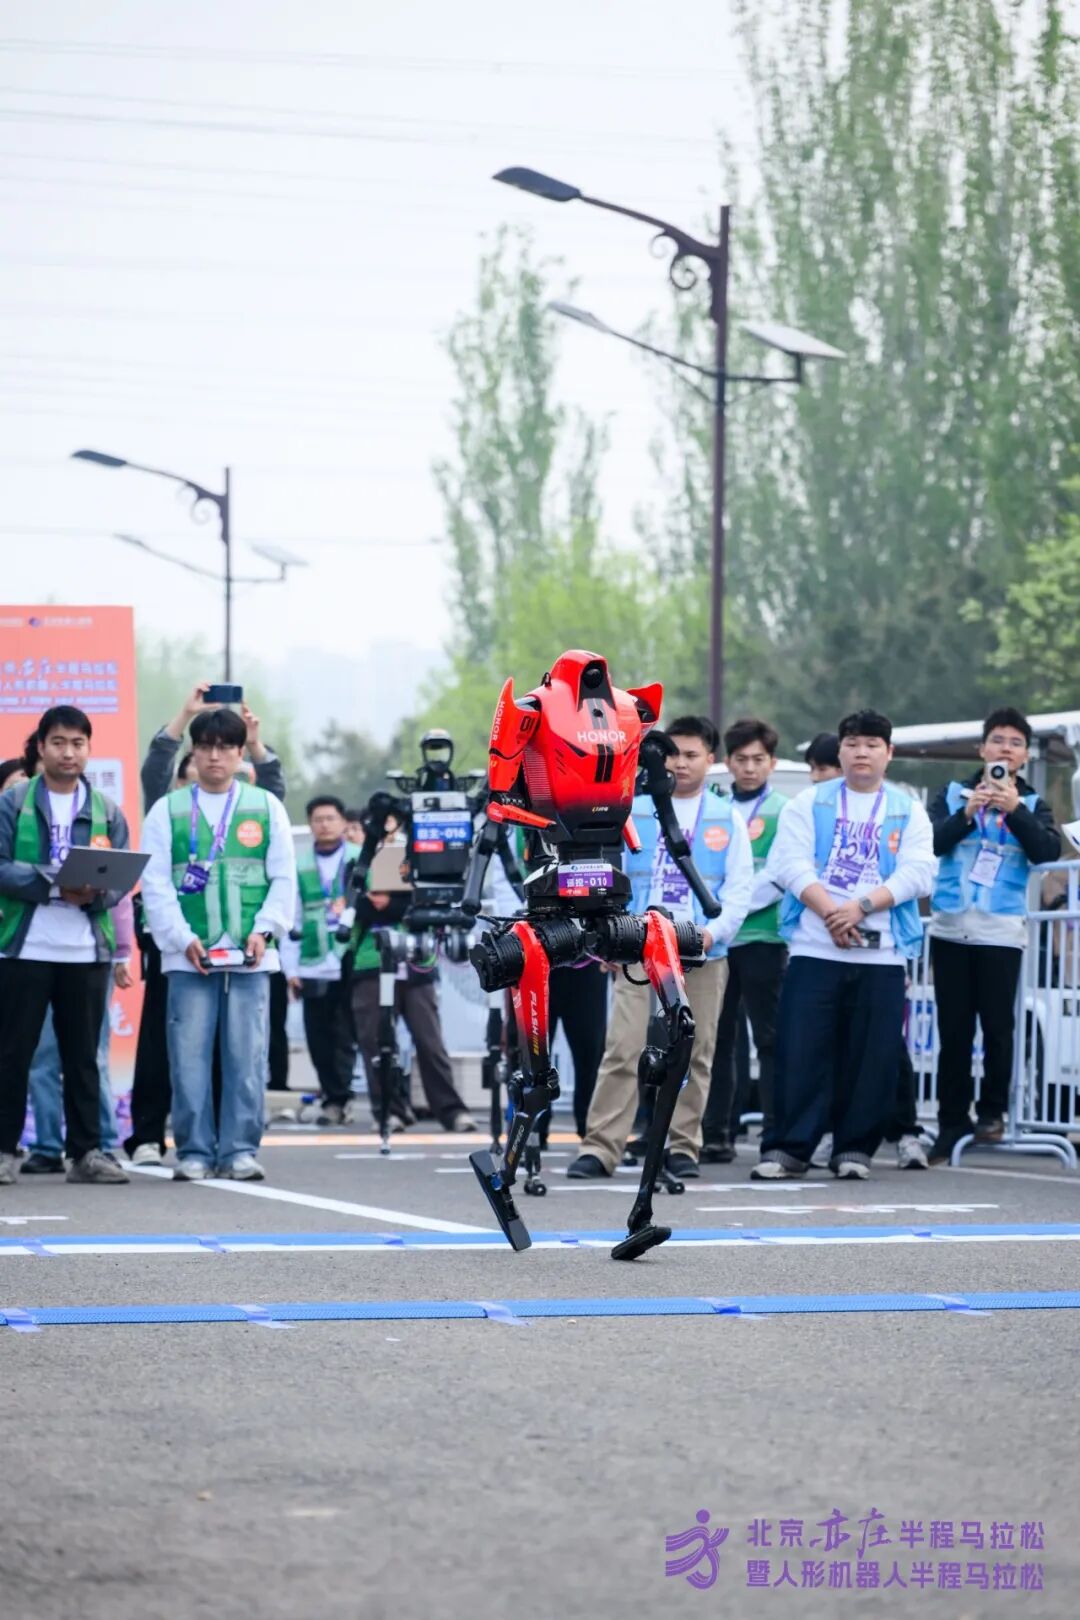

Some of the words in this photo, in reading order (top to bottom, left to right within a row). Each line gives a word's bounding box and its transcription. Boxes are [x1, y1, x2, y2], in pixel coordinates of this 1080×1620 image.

[492, 701, 506, 741] HONOR
[576, 730, 627, 743] HONOR
[530, 990, 539, 1036] FLASH
